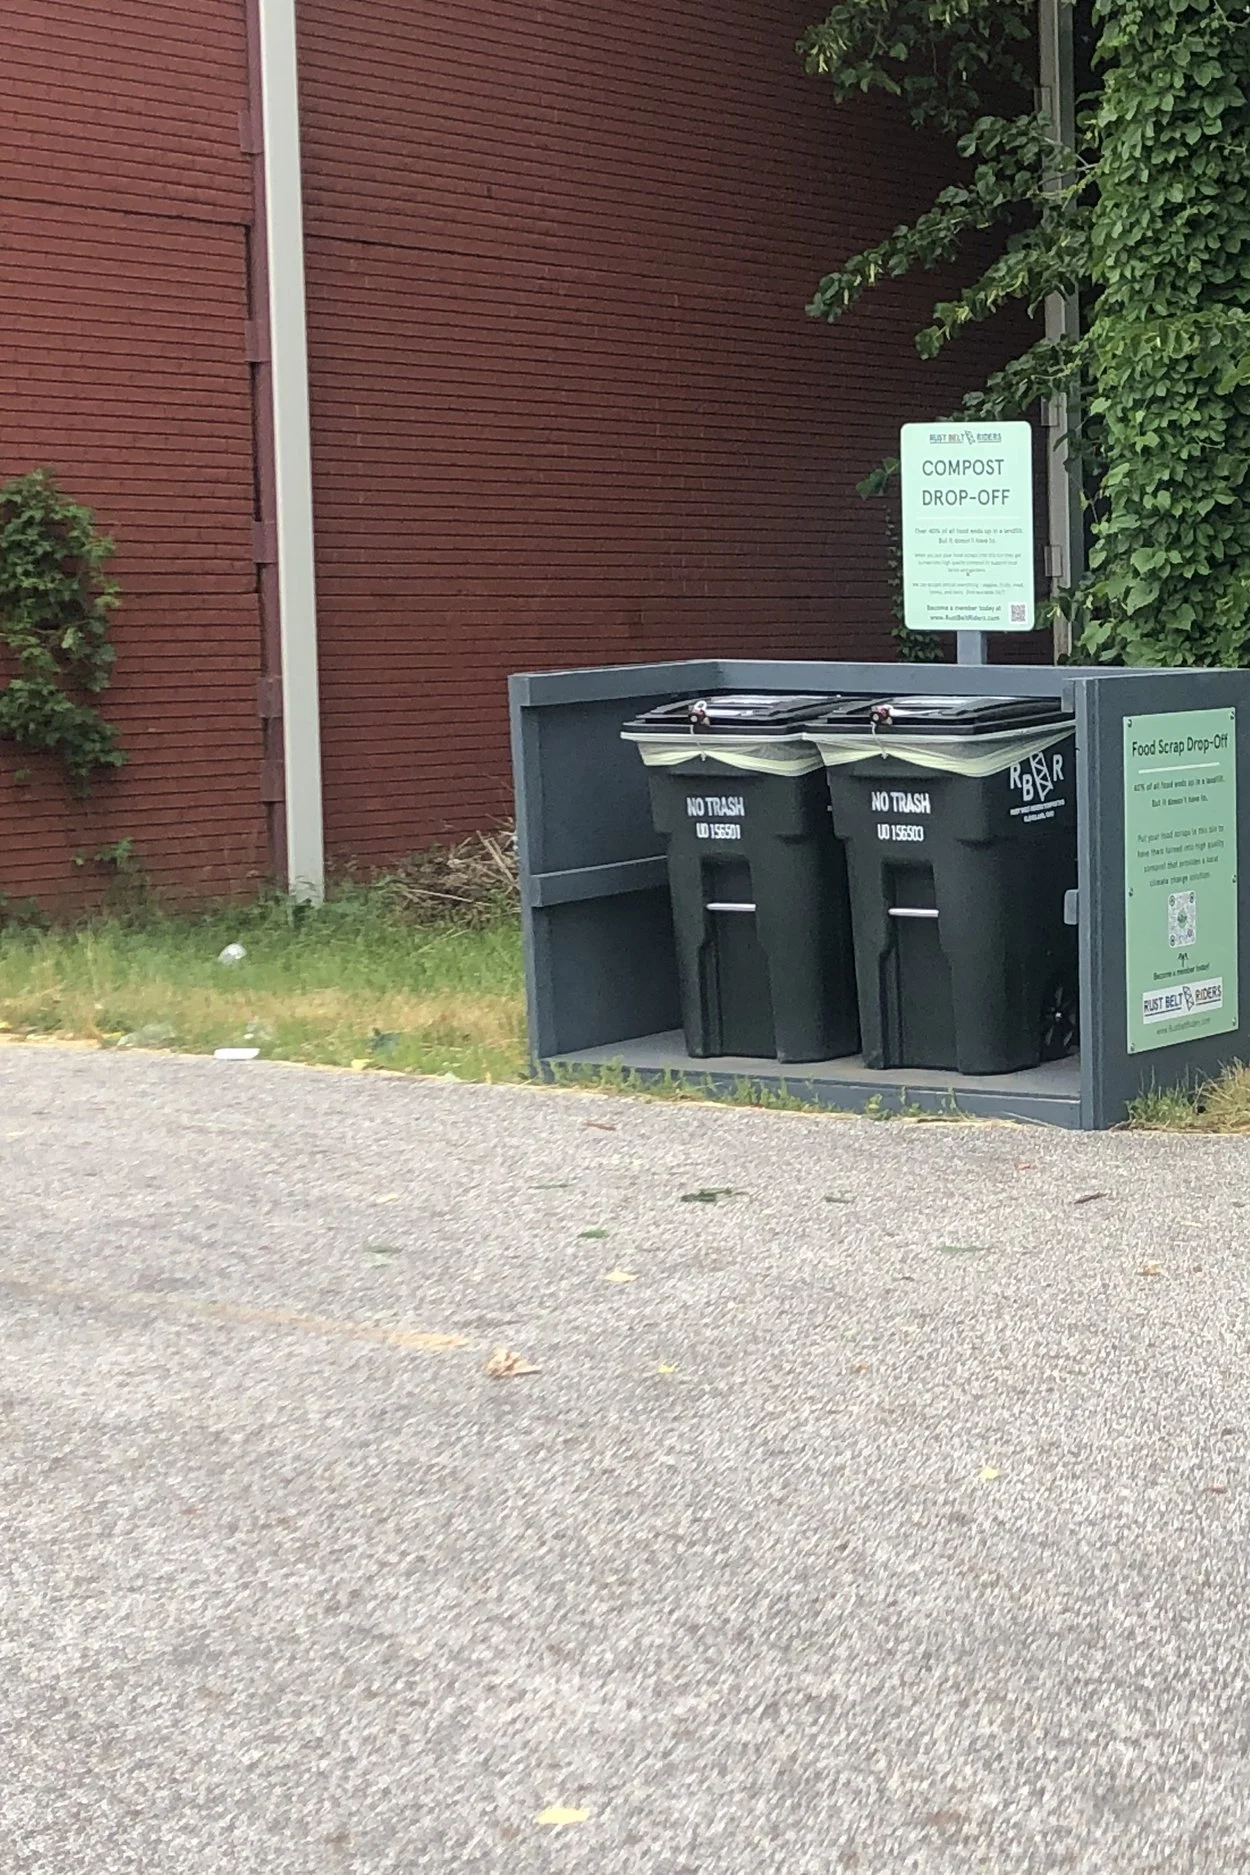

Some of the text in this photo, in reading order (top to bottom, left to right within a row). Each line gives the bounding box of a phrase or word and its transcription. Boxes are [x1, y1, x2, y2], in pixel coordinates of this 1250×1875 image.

[922, 459, 1004, 476] COMPOST
[922, 489, 1010, 506] DROP-OFF
[1132, 733, 1228, 757] Food Scrap Drop-Off
[686, 796, 745, 817] NO TRASH
[871, 791, 931, 814] NO TRASH
[1144, 984, 1222, 1013] RUST BELT RIDERS
